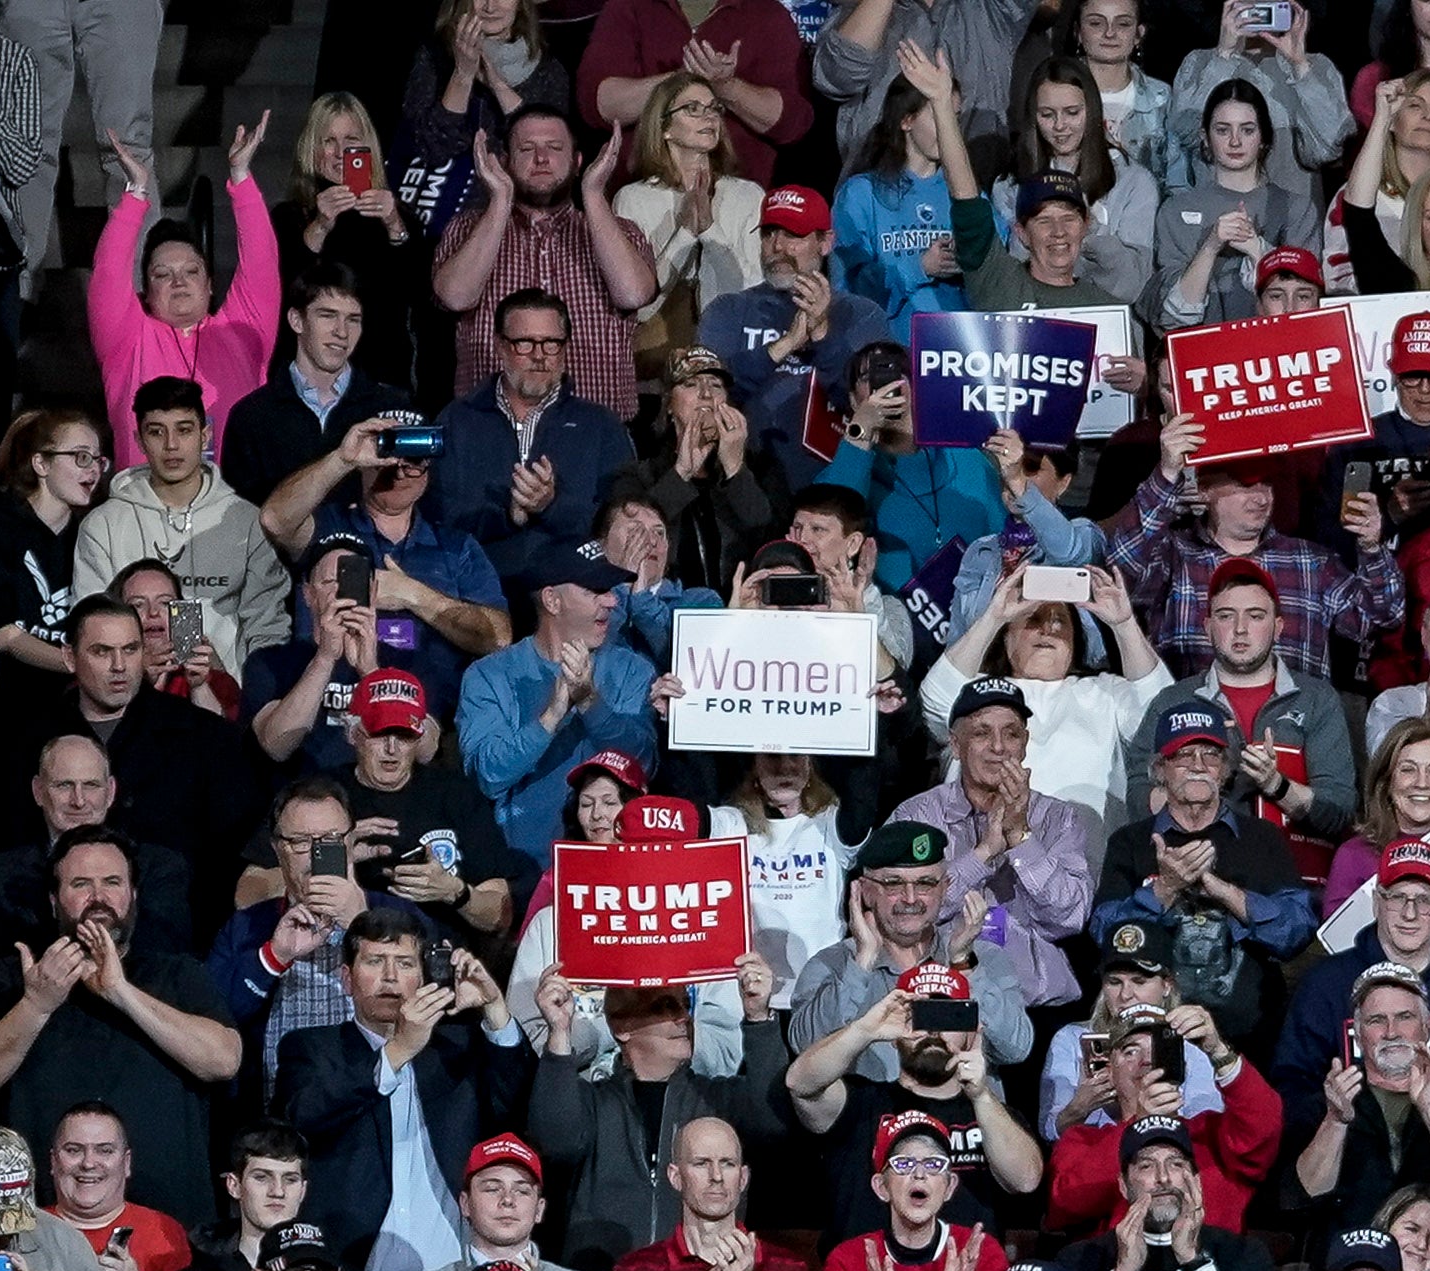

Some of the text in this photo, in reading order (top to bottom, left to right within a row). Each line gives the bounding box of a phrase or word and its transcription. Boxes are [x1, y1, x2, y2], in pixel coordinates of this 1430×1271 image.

[919, 348, 1084, 387] PROMISES
[1185, 346, 1343, 393] TRUMP
[962, 384, 1049, 416] KEPT
[1202, 373, 1332, 412] PENCE
[1217, 403, 1288, 422] KEEP AMERICA
[1267, 443, 1289, 456] 2020
[686, 645, 859, 695] Women
[369, 681, 420, 701] TRUMP
[705, 697, 843, 718] FOR TRUMP
[1168, 712, 1213, 729] Trump
[642, 806, 686, 833] USA
[567, 878, 733, 915] TRUMP
[581, 906, 717, 931] PENCE
[593, 931, 707, 946] KEEP AMERICA GREAT!
[639, 974, 662, 987] 2020
